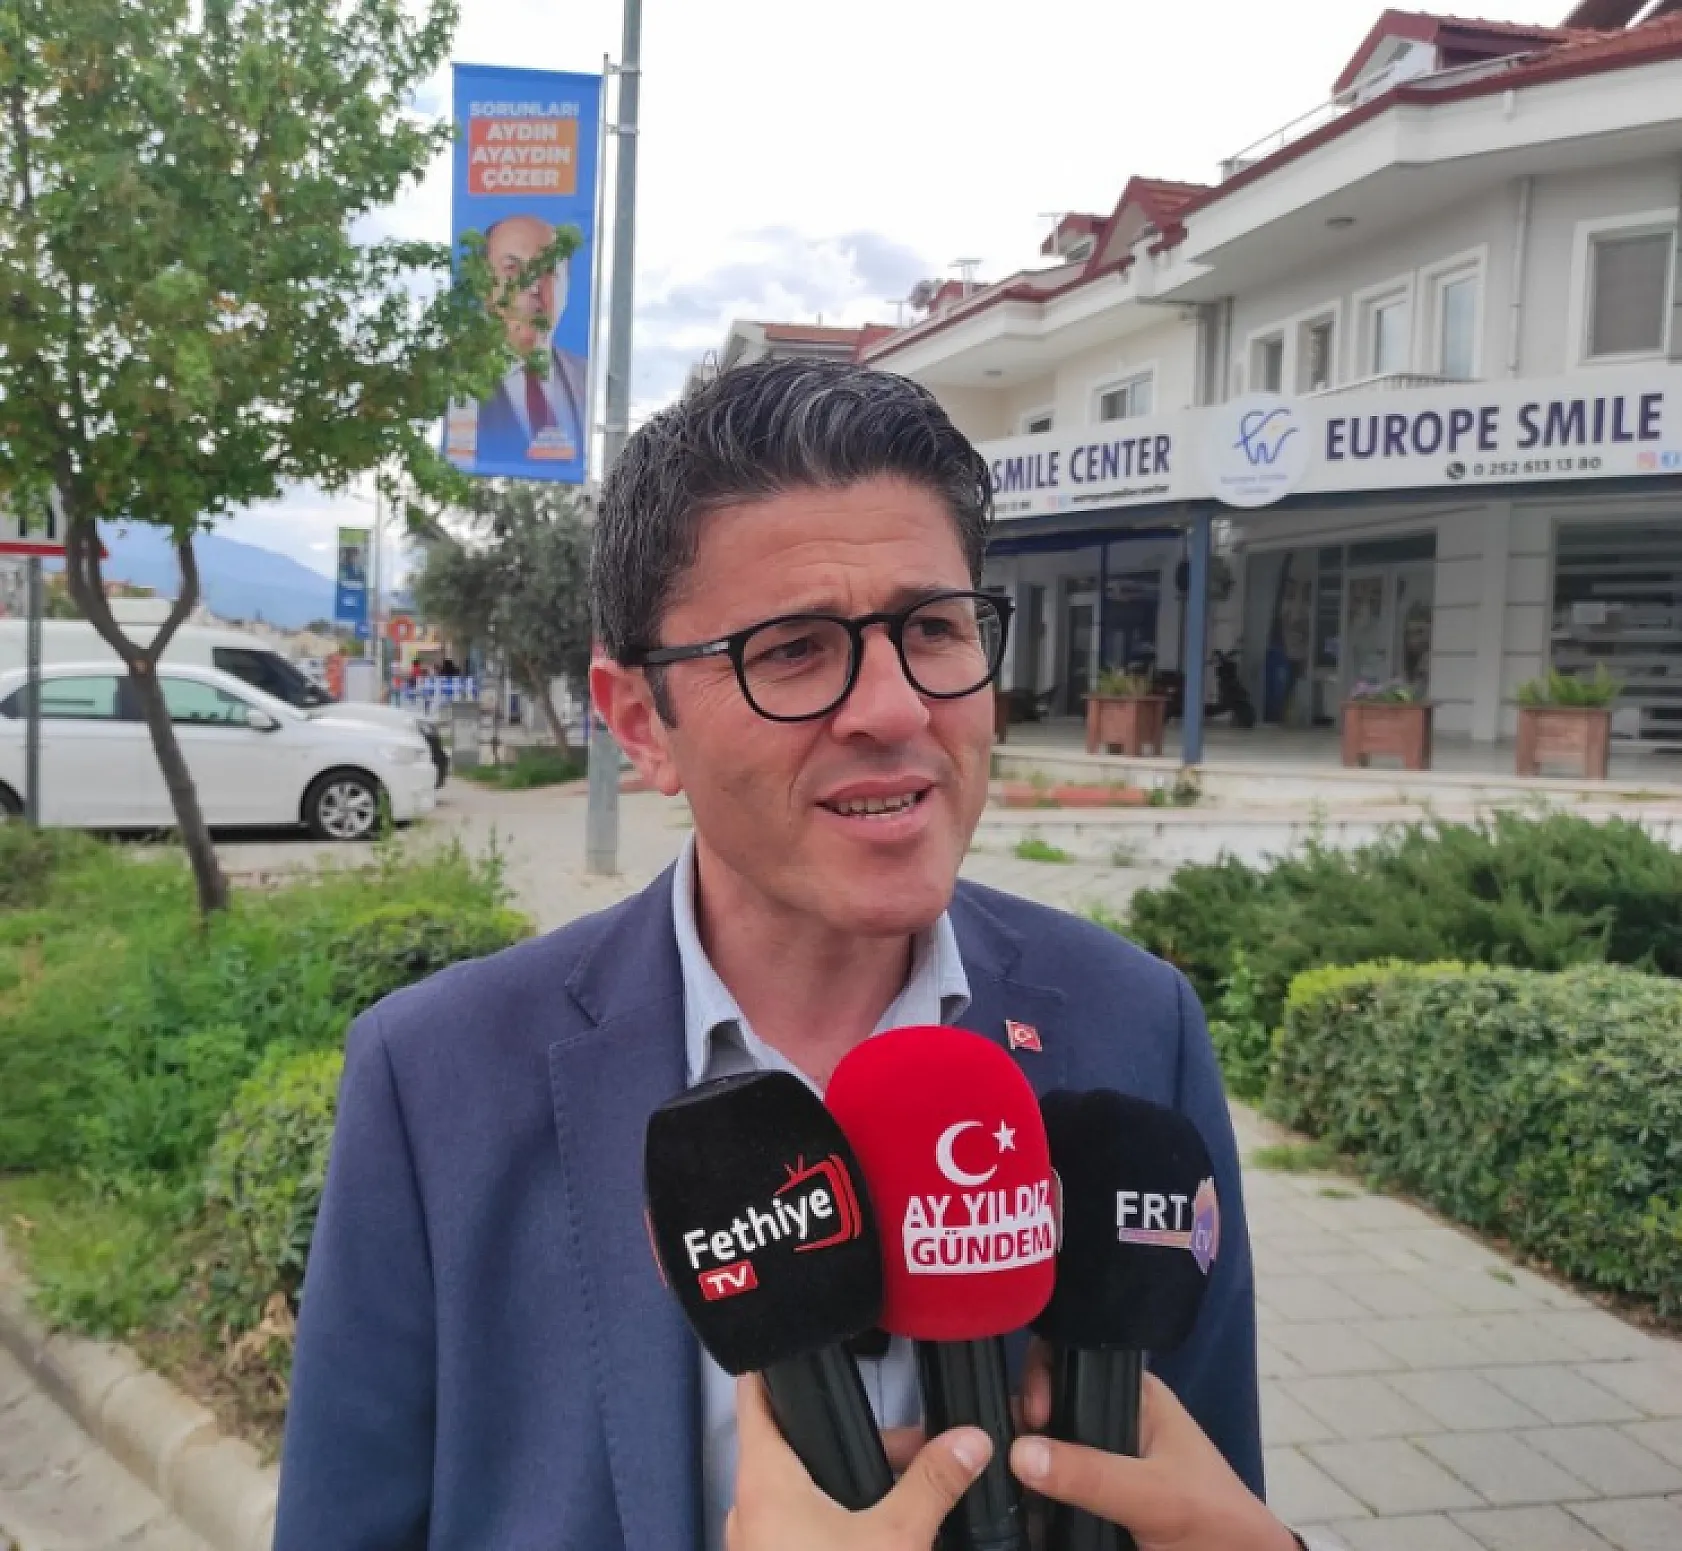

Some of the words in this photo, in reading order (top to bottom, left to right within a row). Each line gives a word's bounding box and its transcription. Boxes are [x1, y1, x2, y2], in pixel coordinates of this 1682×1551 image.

[486, 122, 558, 141] AYDIN
[472, 146, 572, 164] AYAYDIN
[482, 165, 560, 192] ÇÖZER
[1326, 407, 1499, 461] EUROPE
[1516, 392, 1664, 450] SMILE
[992, 450, 1060, 494] SMILE
[1070, 434, 1171, 484] CENTER
[904, 1194, 952, 1229] AY
[962, 1179, 1051, 1228] YILDIZ
[1116, 1190, 1188, 1230] FRT
[683, 1187, 833, 1270] Fethiye
[911, 1221, 1053, 1267] GÜNDEM
[706, 1265, 748, 1295] TV
